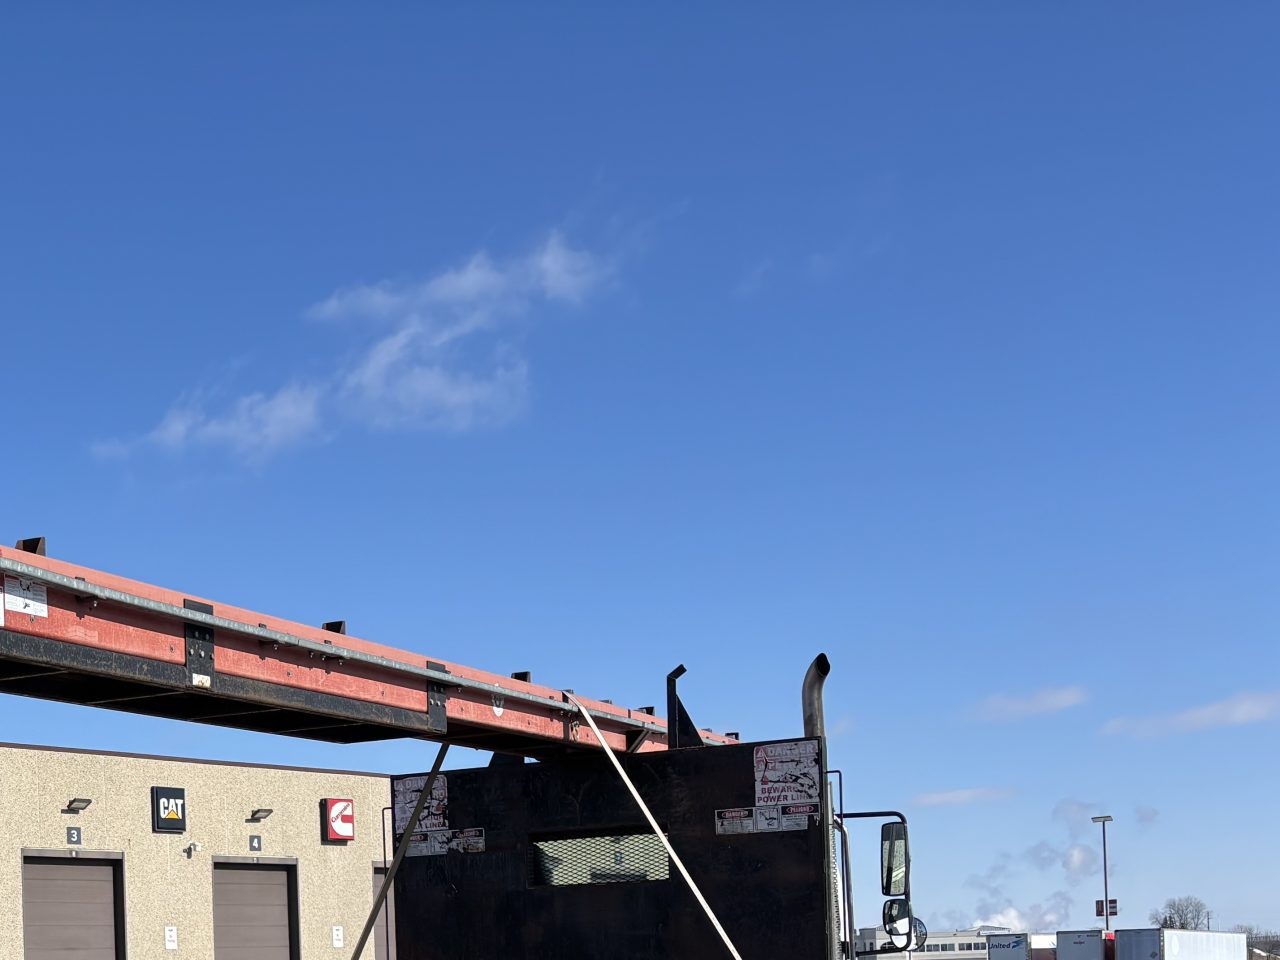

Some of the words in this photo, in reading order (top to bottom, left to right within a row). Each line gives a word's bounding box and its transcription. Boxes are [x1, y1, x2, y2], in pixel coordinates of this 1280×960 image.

[757, 794, 789, 804] POWER
[159, 797, 184, 820] CAT
[70, 829, 78, 842] 3
[252, 838, 259, 849] 4
